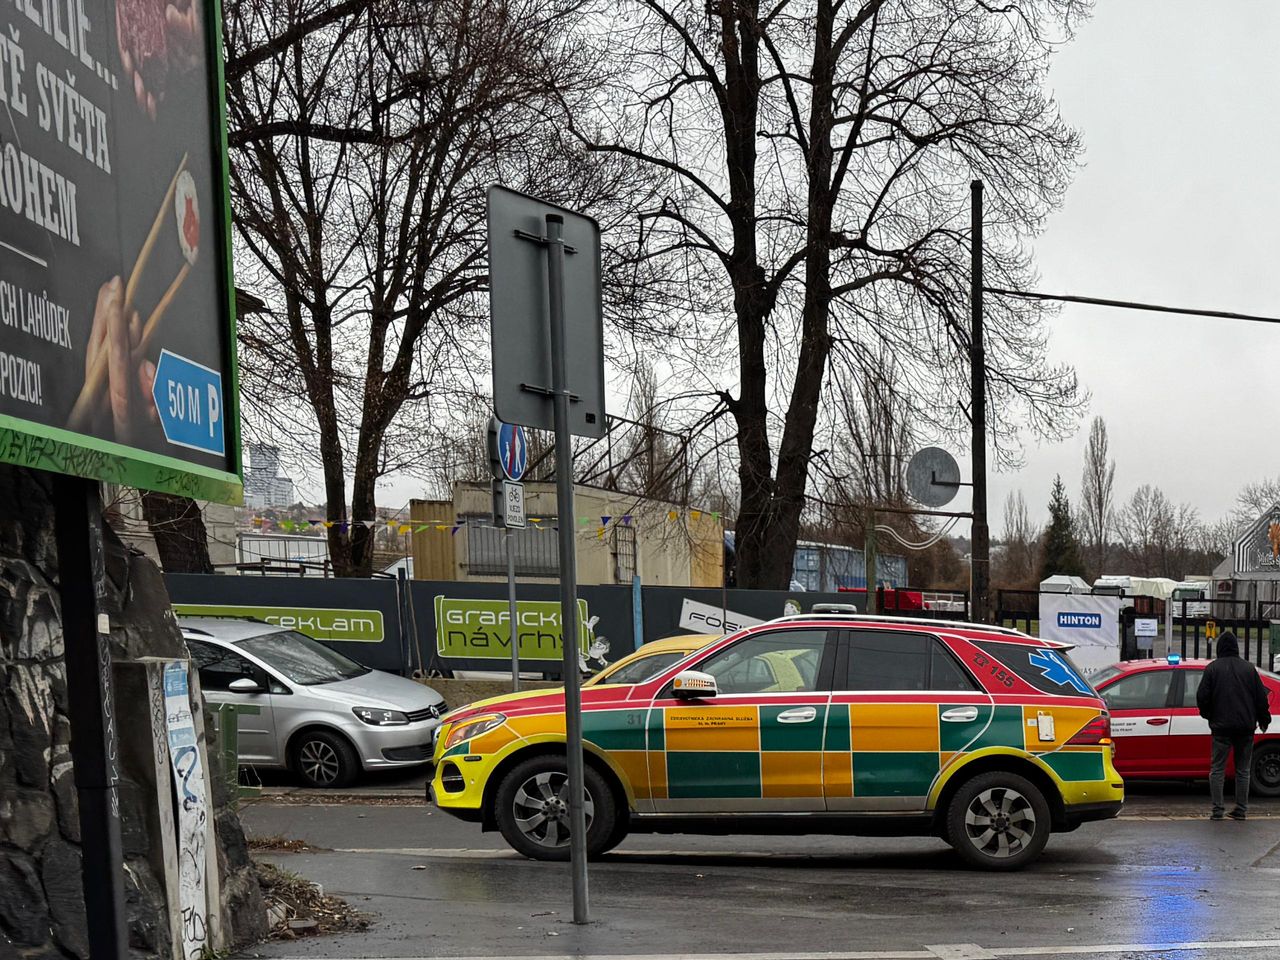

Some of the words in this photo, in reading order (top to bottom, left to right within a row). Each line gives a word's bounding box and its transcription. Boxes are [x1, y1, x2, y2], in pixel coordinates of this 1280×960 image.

[36, 62, 111, 174] SVĚTA
[20, 290, 72, 350] LAHŮDEK
[168, 379, 184, 421] 50
[188, 385, 200, 425] M
[1060, 615, 1099, 625] HINTON
[448, 627, 563, 648] návrh
[991, 666, 1014, 688] 155
[627, 714, 642, 726] 31
